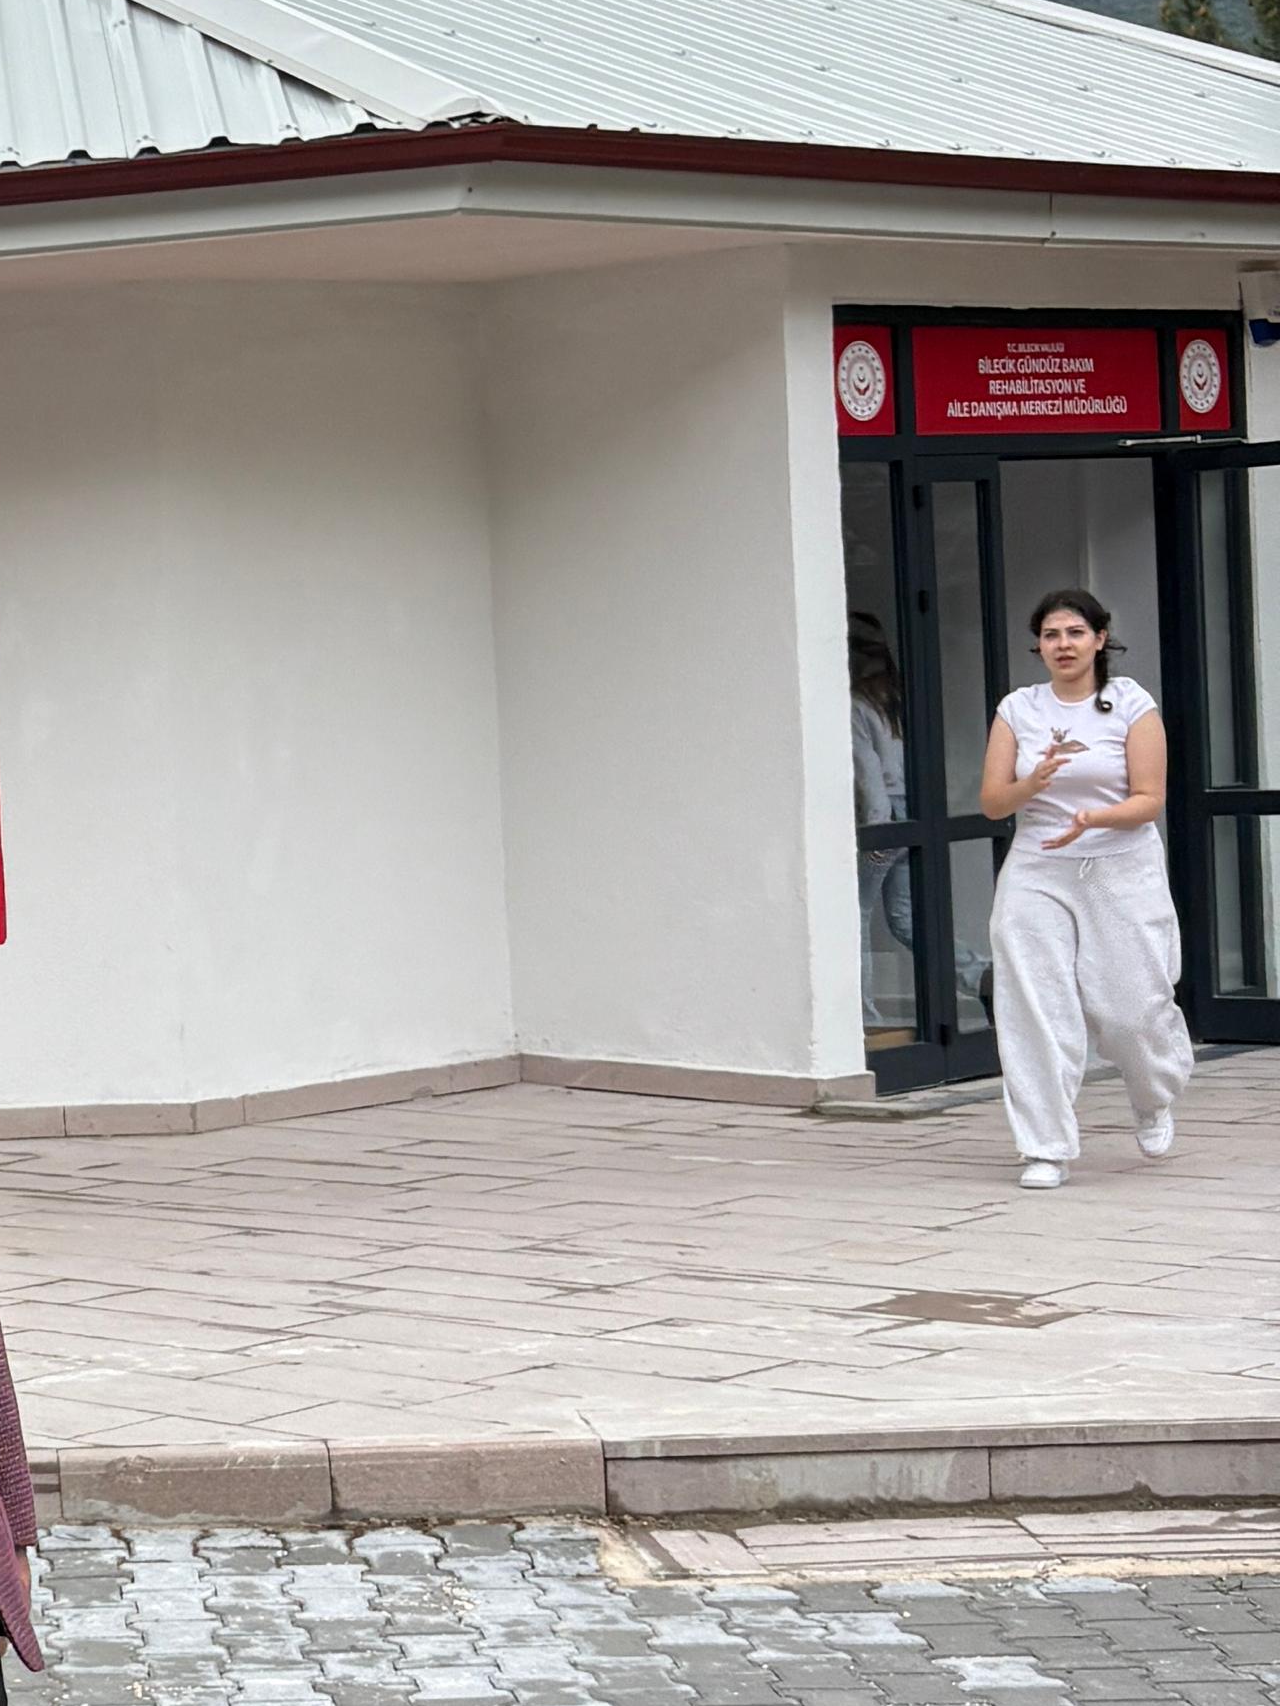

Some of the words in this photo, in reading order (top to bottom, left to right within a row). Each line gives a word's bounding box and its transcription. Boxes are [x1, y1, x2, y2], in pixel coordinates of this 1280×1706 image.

[978, 355, 1016, 374] BİLECİK
[1017, 356, 1061, 373] GÜNDÜZ
[1063, 357, 1094, 373] BAKIM
[989, 376, 1073, 395] REHABİLİTASYON
[1074, 378, 1087, 394] VE
[947, 399, 970, 417] AİLE
[971, 401, 1019, 419] DANIŞMA
[1020, 397, 1062, 416] MERKEZİ
[1064, 395, 1128, 415] MÜDÜRLÜĞÜ
